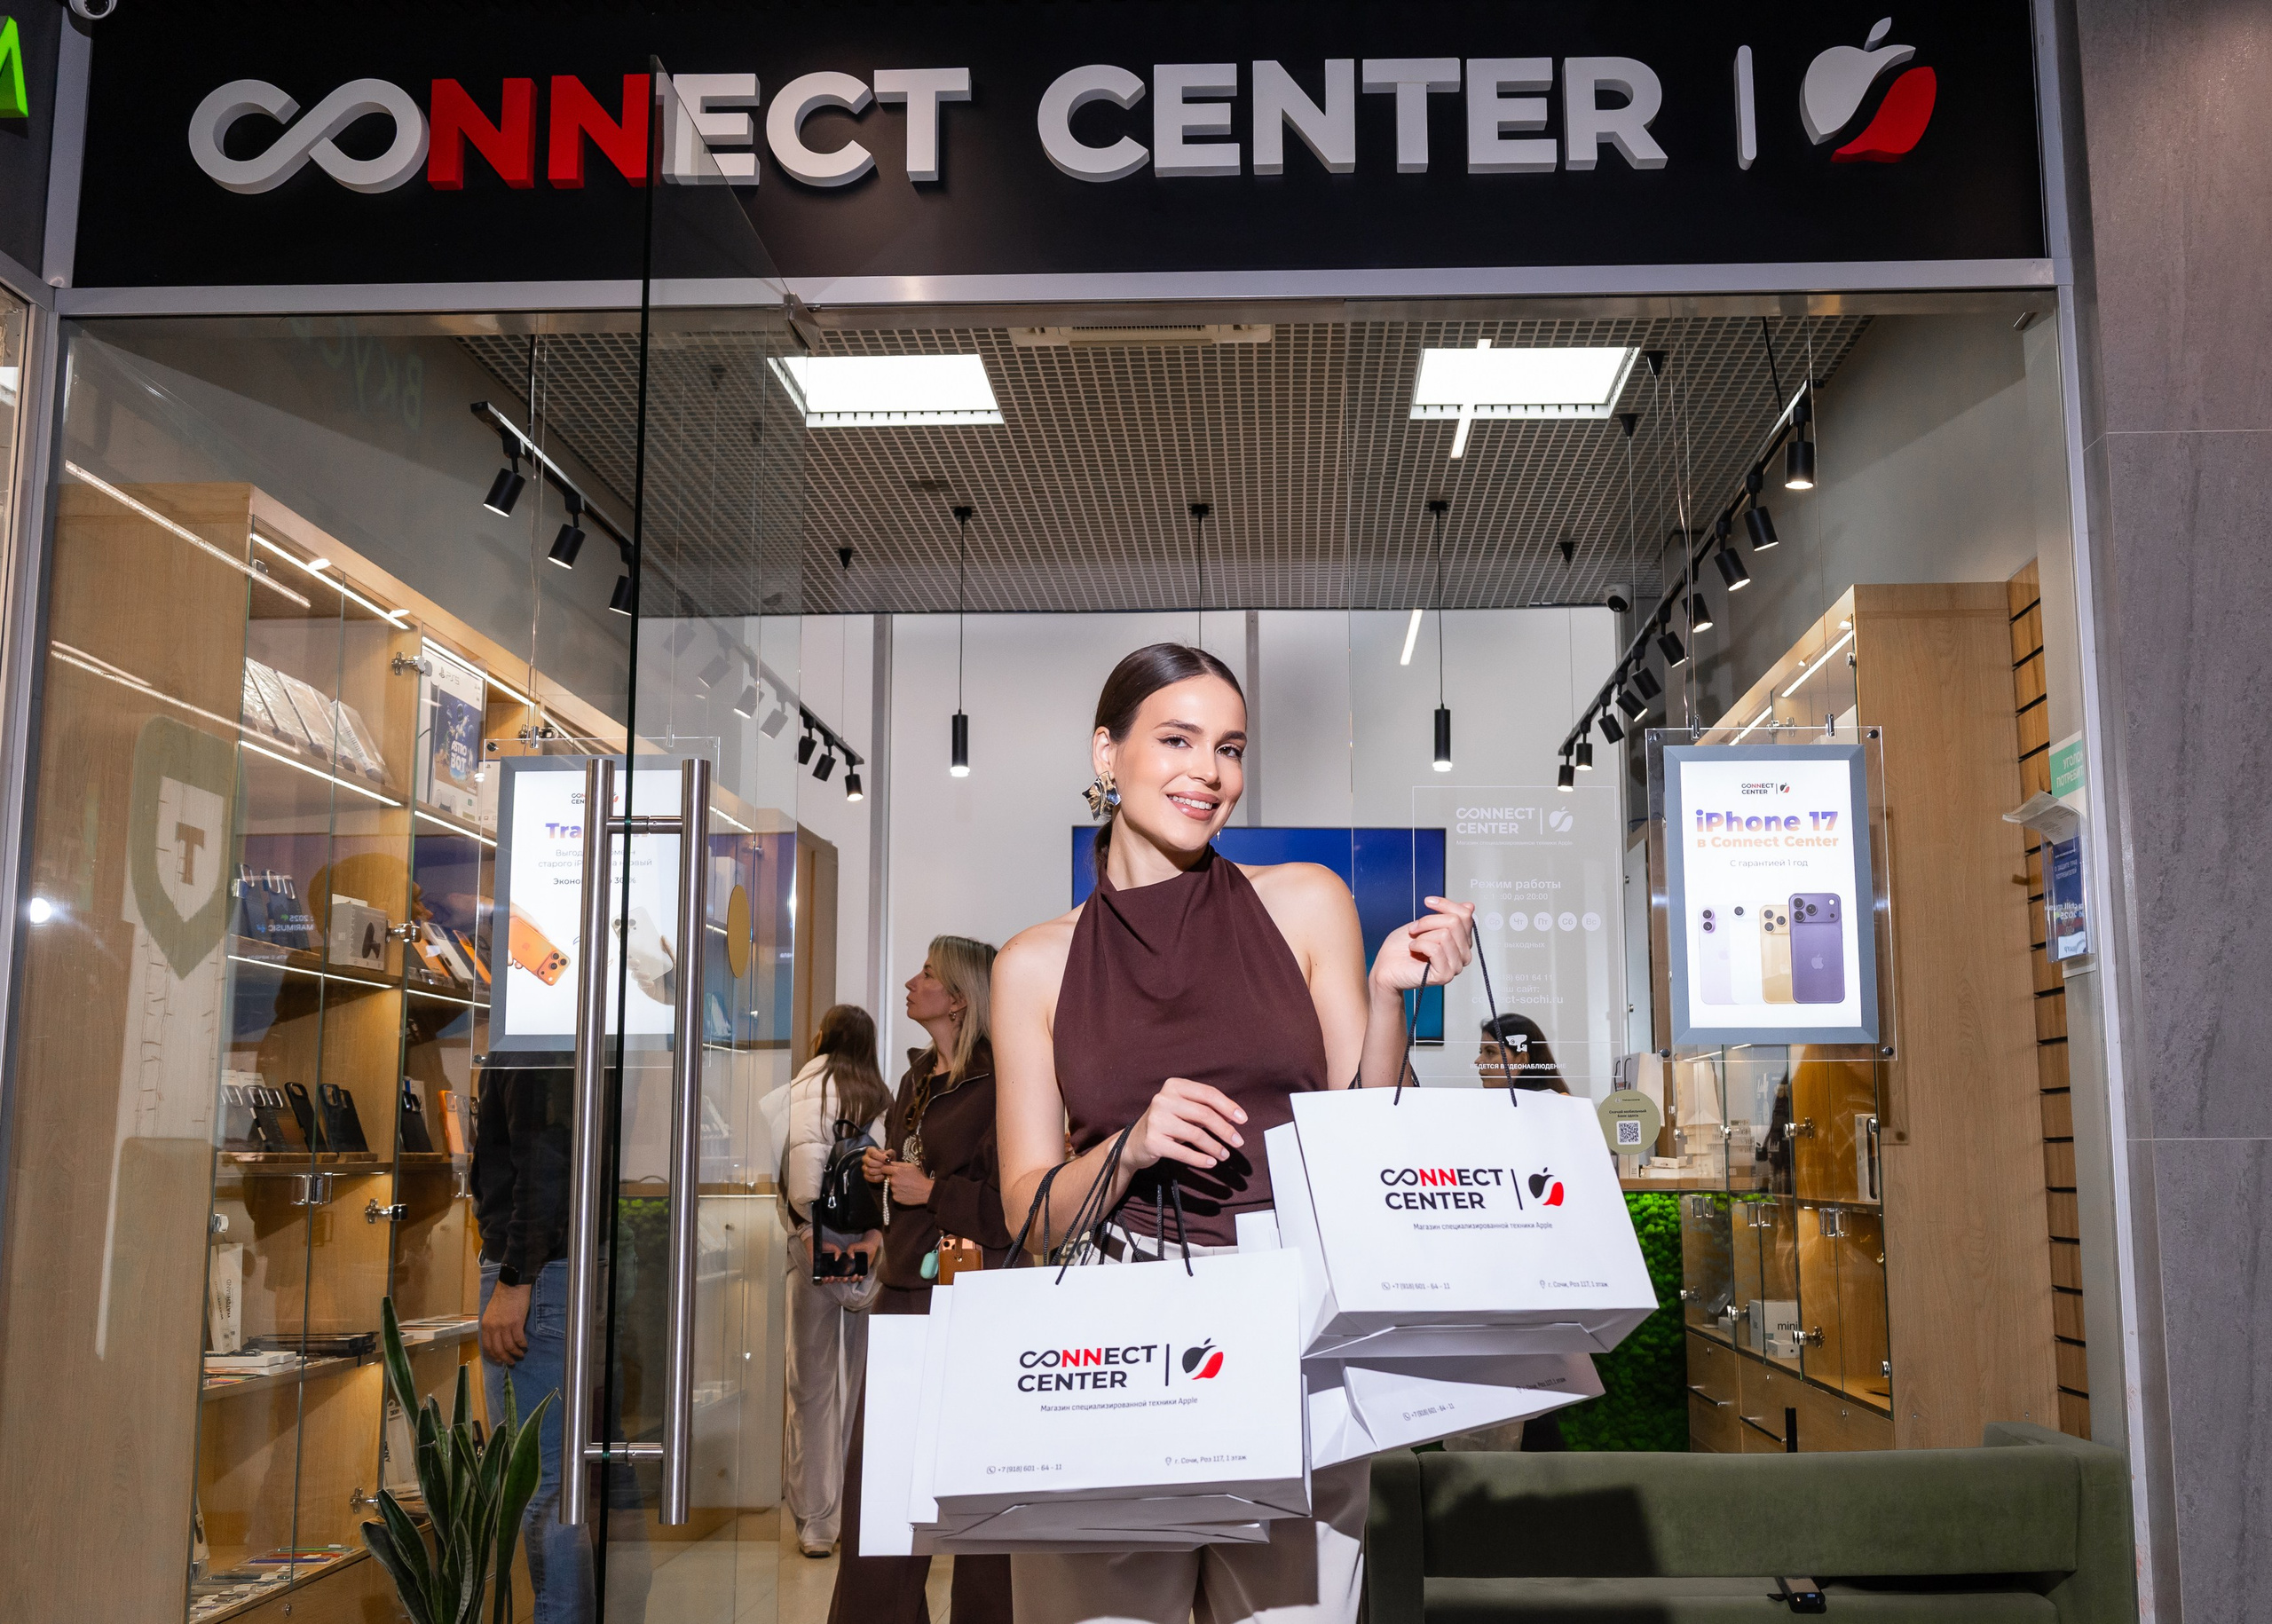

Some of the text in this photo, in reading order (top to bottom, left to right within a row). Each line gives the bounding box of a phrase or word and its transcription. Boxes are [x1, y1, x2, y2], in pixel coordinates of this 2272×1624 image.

[188, 57, 1668, 194] CONNECT CENTER
[450, 752, 467, 773] BOT
[1456, 807, 1535, 820] CONNECT
[1696, 809, 1838, 832] iPhone 17
[1456, 822, 1519, 834] CENTER
[1697, 835, 1839, 847] в Connect Center
[538, 860, 572, 869] старого
[1739, 858, 1786, 868] гарантией
[1470, 879, 1562, 891] Режим работы
[1380, 1168, 1503, 1186] CONNECT
[1384, 1192, 1487, 1210] CENTER
[1442, 1221, 1509, 1231] специализированной
[1535, 1221, 1553, 1230] Apple
[1777, 1320, 1798, 1330] mini
[1019, 1344, 1158, 1369] CONNECT
[1017, 1370, 1128, 1392] CENTER
[1071, 1400, 1148, 1412] специализированной
[1178, 1396, 1198, 1406] Apple
